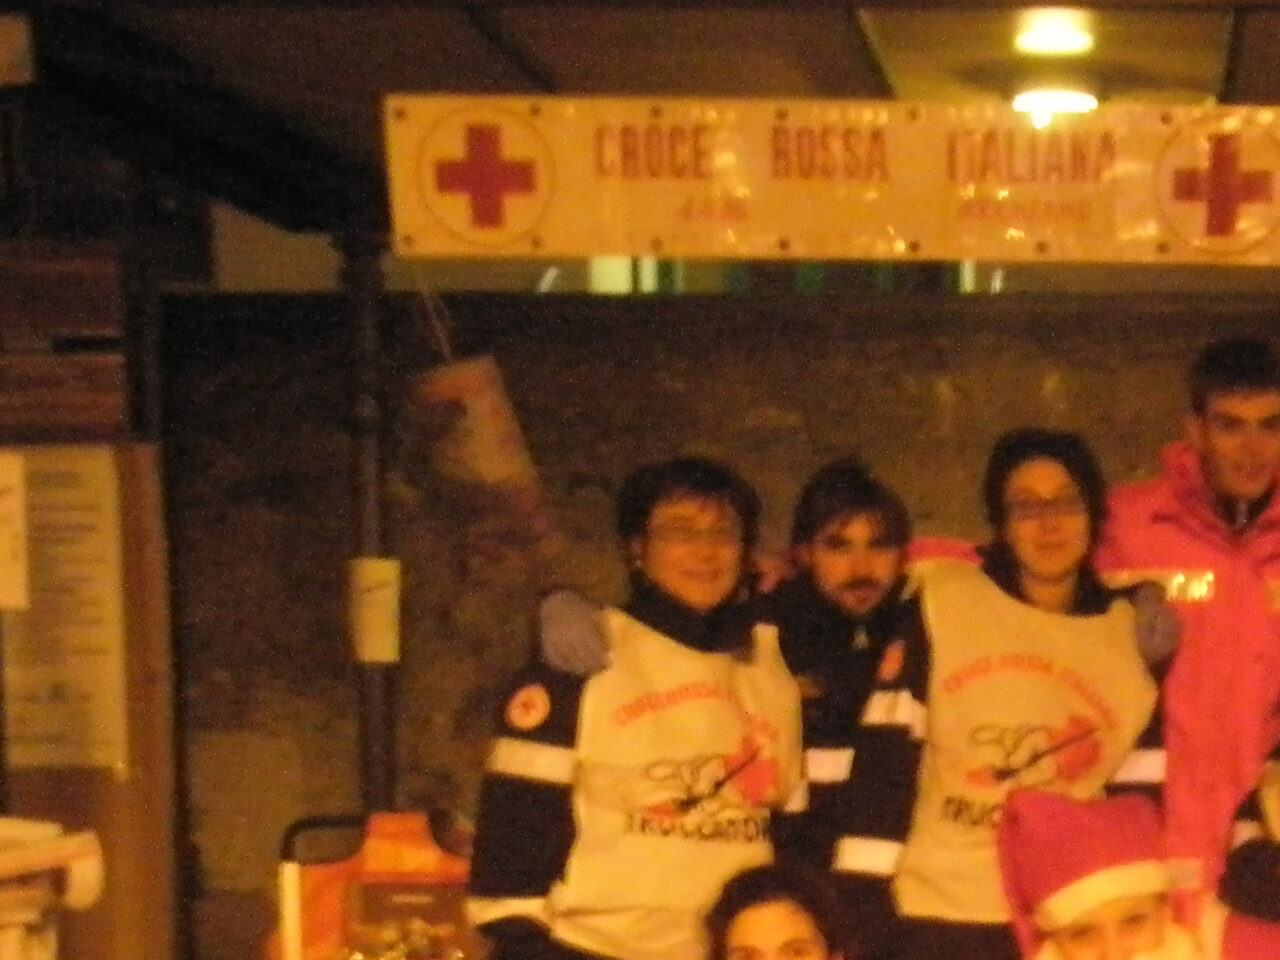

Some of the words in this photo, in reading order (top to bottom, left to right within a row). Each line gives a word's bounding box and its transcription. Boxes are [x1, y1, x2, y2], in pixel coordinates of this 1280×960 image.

[594, 122, 712, 180] CROCE
[771, 123, 890, 181] ROSSA
[945, 127, 1118, 184] ITALIANA
